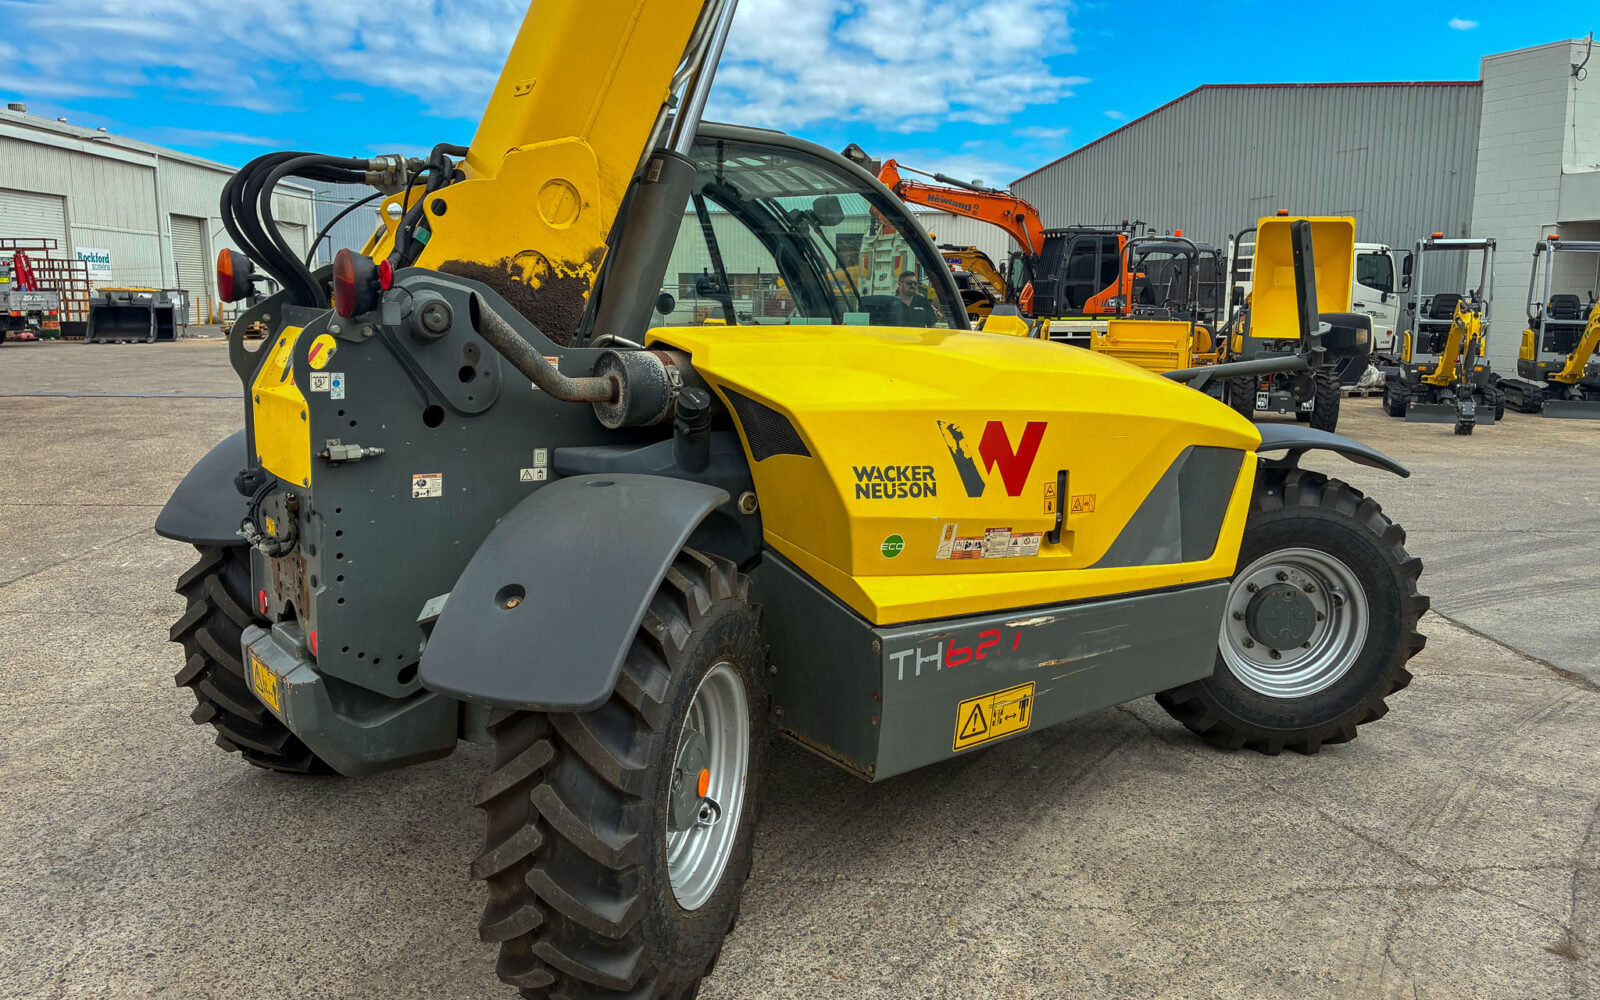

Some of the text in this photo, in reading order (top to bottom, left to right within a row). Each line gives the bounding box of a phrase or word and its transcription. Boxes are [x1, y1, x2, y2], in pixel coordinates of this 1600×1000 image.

[927, 194, 972, 212] Newland
[77, 252, 110, 264] Rockford
[852, 465, 937, 483] WACKER
[855, 482, 937, 500] NEUSON
[880, 541, 905, 551] ECO
